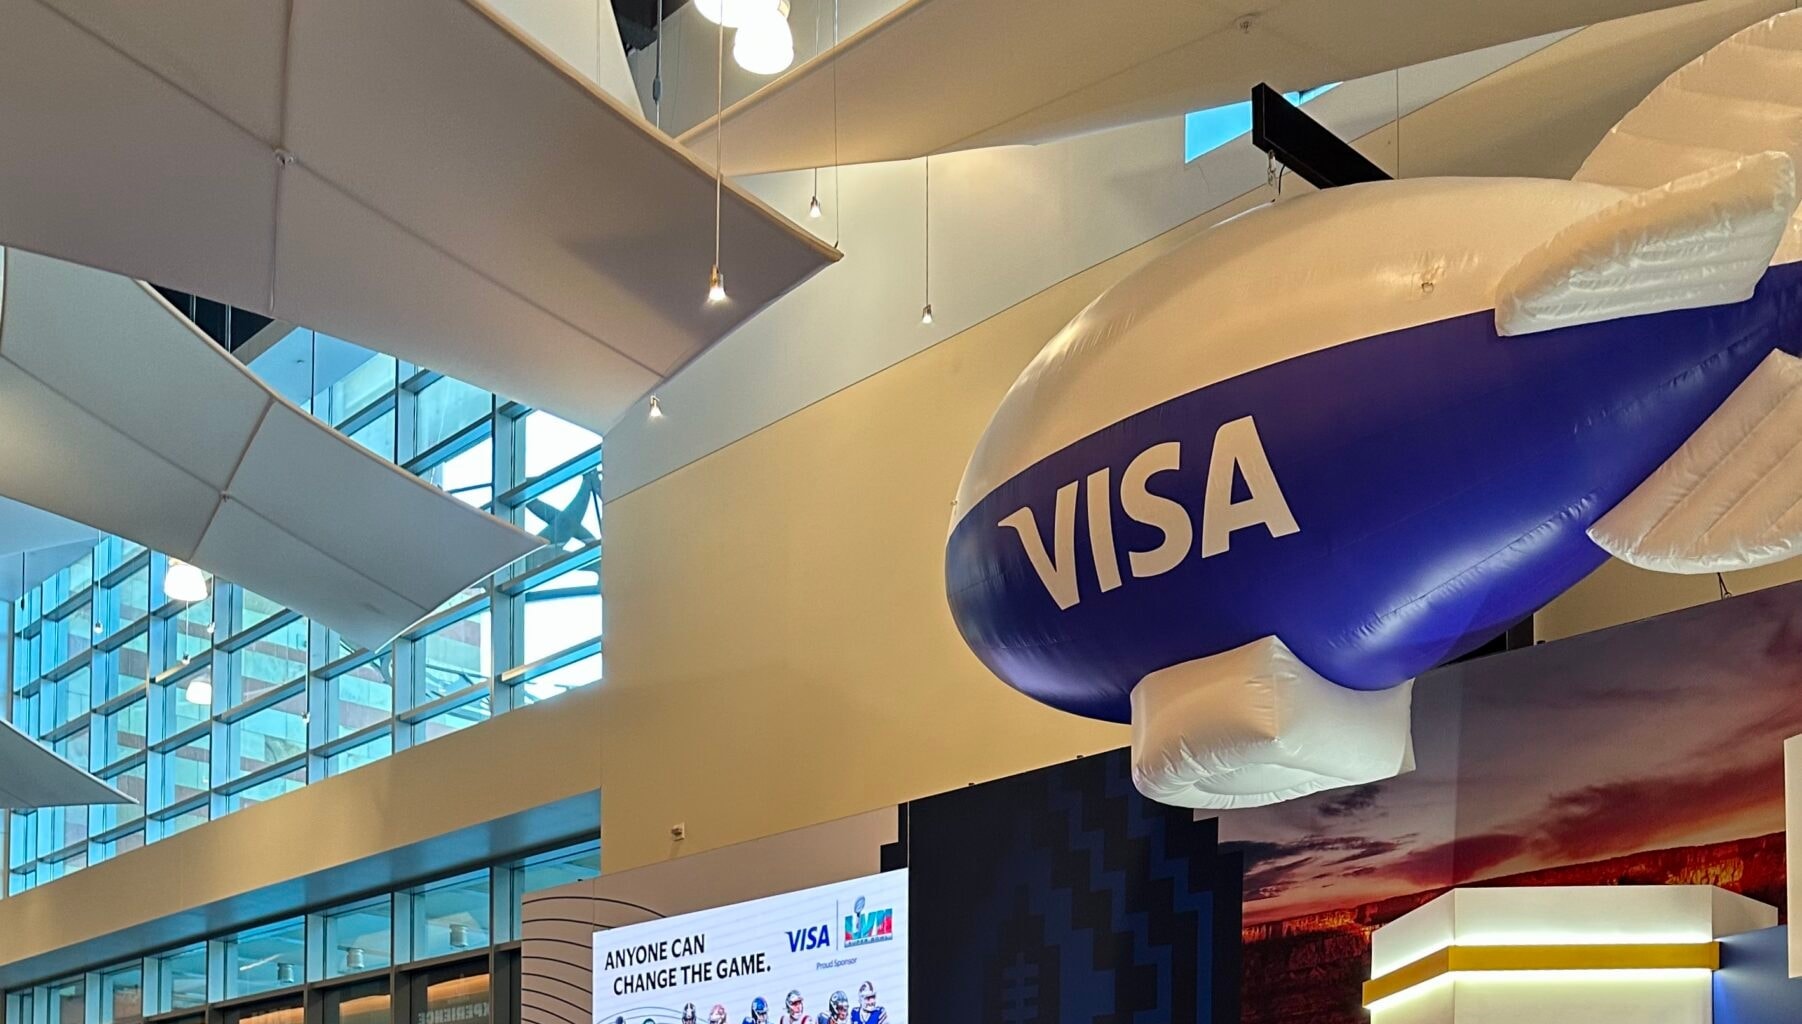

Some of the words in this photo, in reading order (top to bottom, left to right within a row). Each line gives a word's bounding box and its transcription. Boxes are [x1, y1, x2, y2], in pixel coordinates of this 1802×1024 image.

[997, 415, 1301, 611] VISA
[605, 941, 668, 971] ANYONE
[671, 934, 706, 958] CAN
[784, 924, 830, 952] VISA
[613, 967, 677, 996] CHANGE
[680, 962, 712, 985] THE
[716, 952, 772, 979] GAME.
[816, 959, 834, 971] Proud
[834, 957, 858, 969] Sponsor
